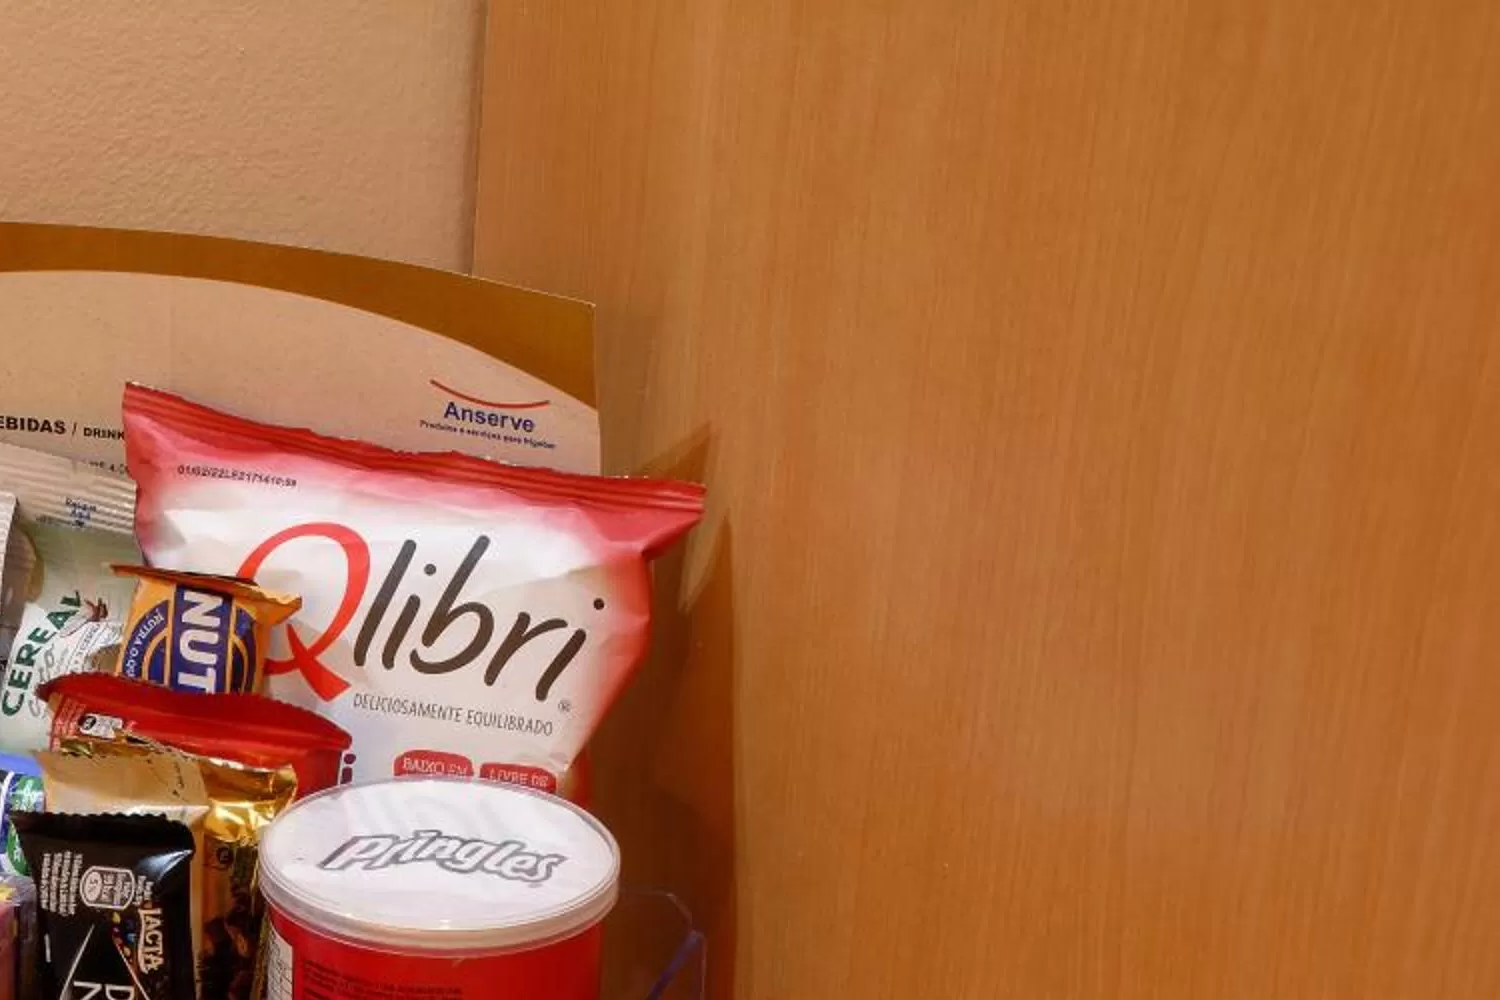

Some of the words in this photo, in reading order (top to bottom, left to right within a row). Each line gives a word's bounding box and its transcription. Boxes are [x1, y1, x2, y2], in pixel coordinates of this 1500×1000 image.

[444, 401, 536, 433] Anserve
[237, 521, 606, 702] Qlibri
[1, 590, 82, 717] CEREAL
[353, 692, 463, 724] DELICIOSAMENTE
[465, 708, 554, 737] EQUILIBRADO
[318, 828, 568, 884] Pringles
[138, 908, 164, 974] LACTA
